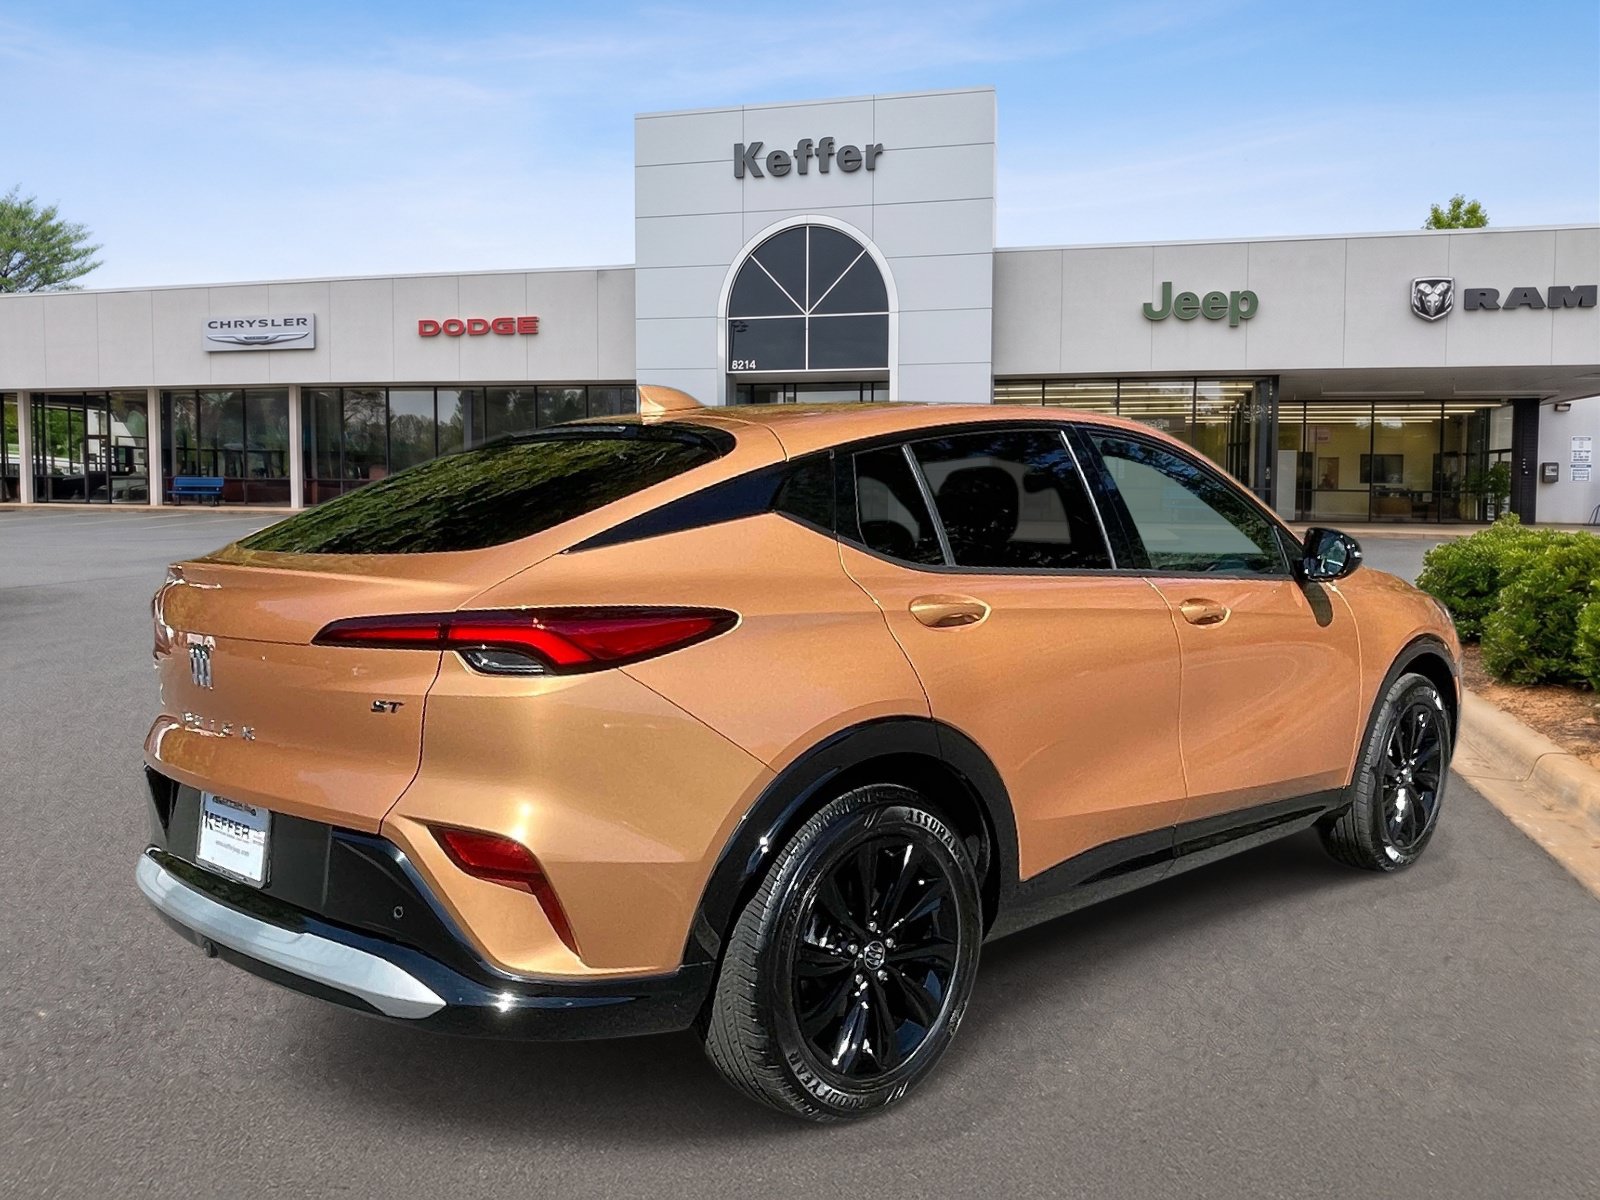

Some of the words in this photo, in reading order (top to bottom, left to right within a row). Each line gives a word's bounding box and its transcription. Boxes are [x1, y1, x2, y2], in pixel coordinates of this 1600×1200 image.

[733, 136, 884, 179] Keffer
[1143, 281, 1259, 327] Jeep
[1463, 284, 1598, 311] RAM
[207, 317, 308, 330] CHRYSLER
[418, 316, 539, 338] DODGE
[731, 359, 756, 370] 8214
[370, 700, 404, 714] ST
